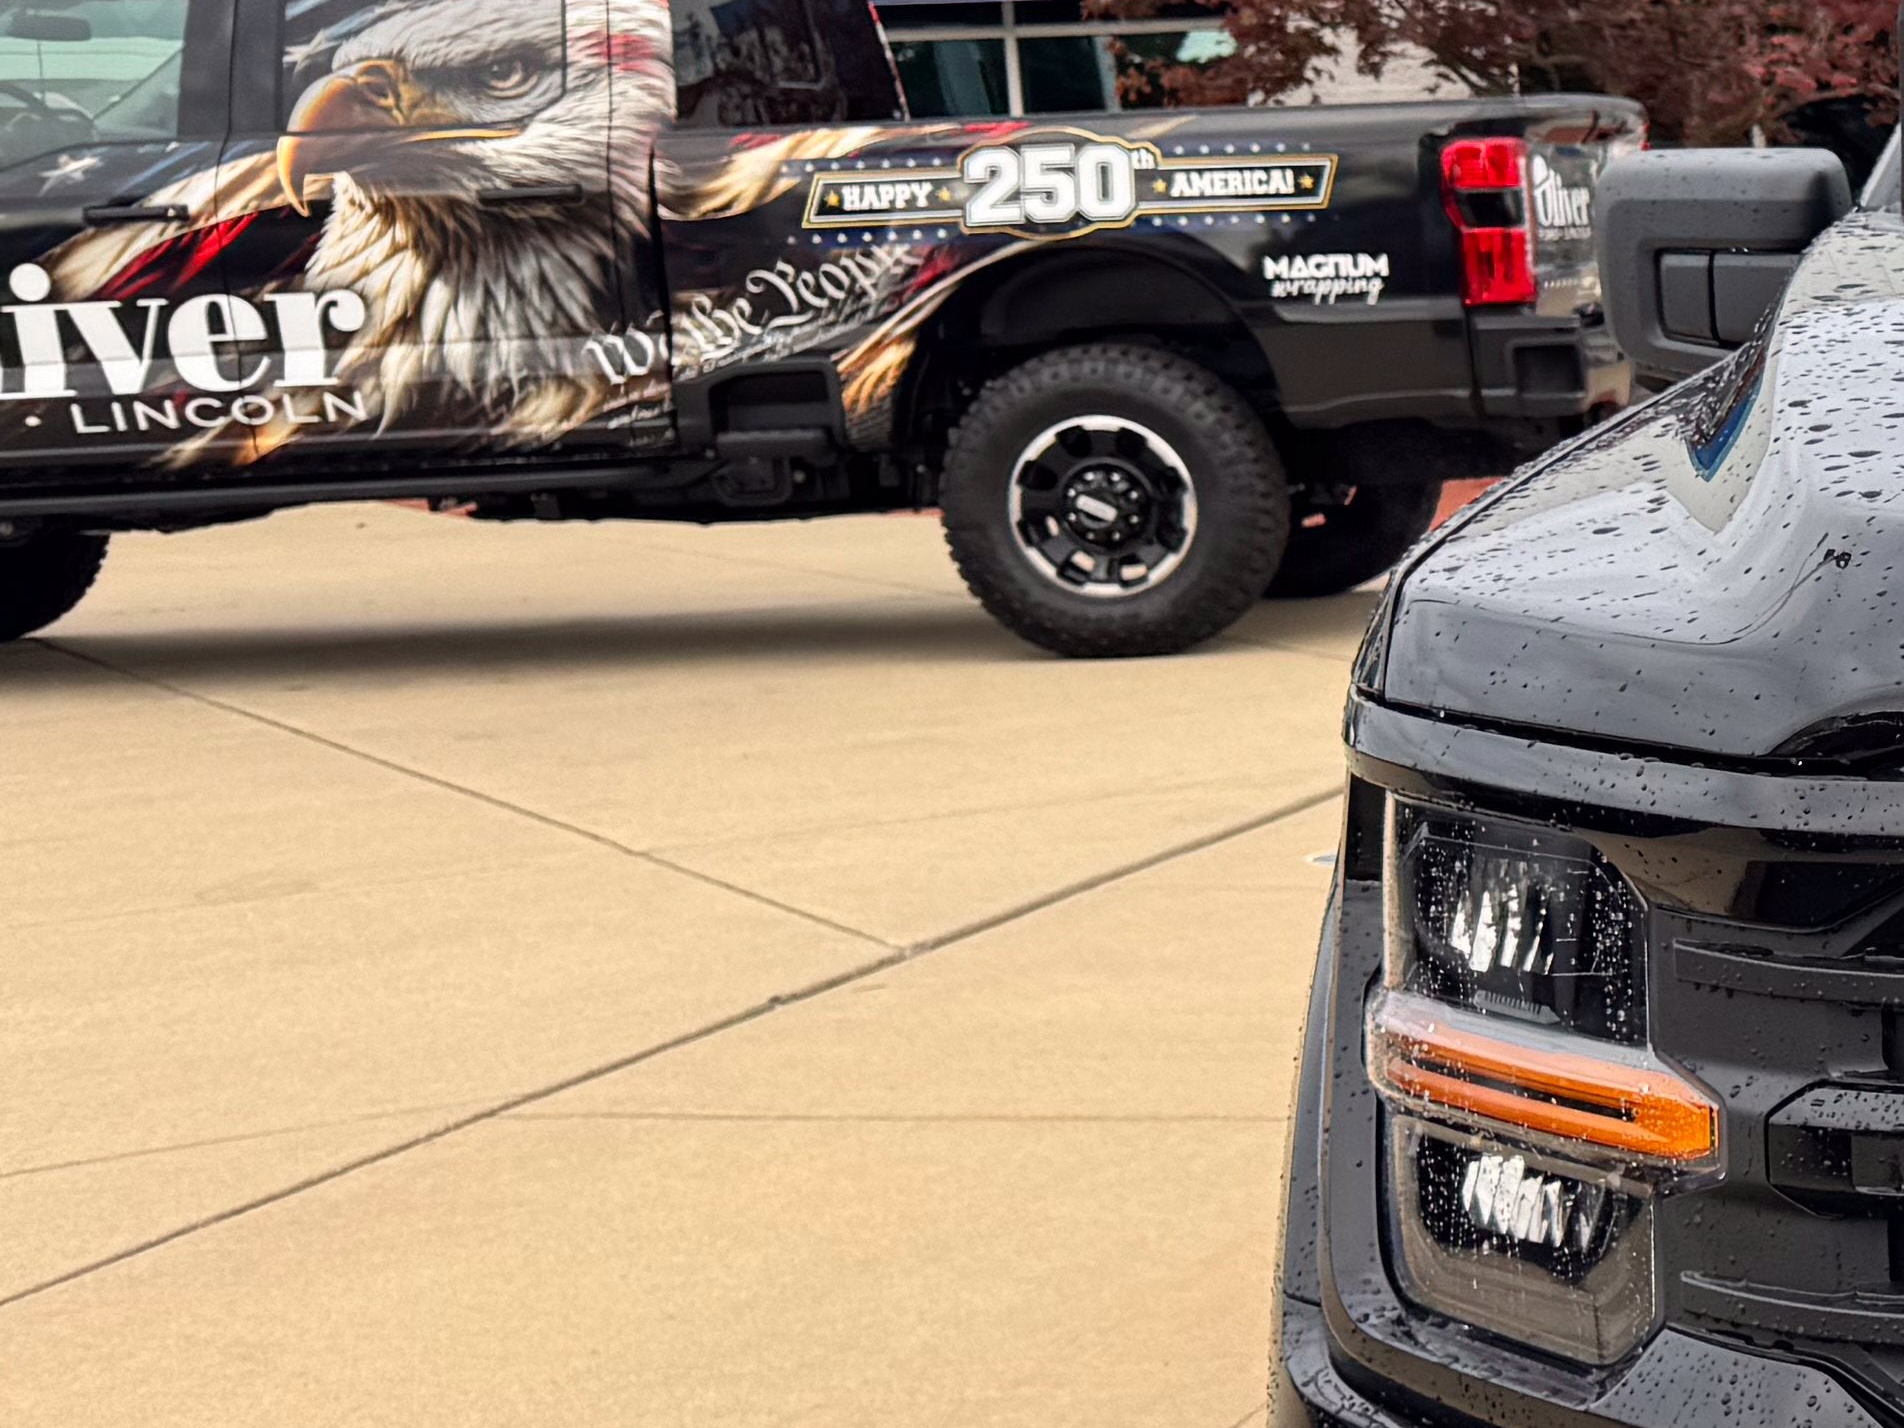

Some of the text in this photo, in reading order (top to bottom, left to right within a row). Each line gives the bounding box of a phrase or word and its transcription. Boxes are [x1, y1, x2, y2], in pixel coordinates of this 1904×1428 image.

[841, 183, 933, 211] HAPPY
[1170, 170, 1295, 198] AMERICA!
[1270, 276, 1385, 306] wrapping
[0, 262, 366, 401] iver
[70, 390, 369, 434] LINCOLN
